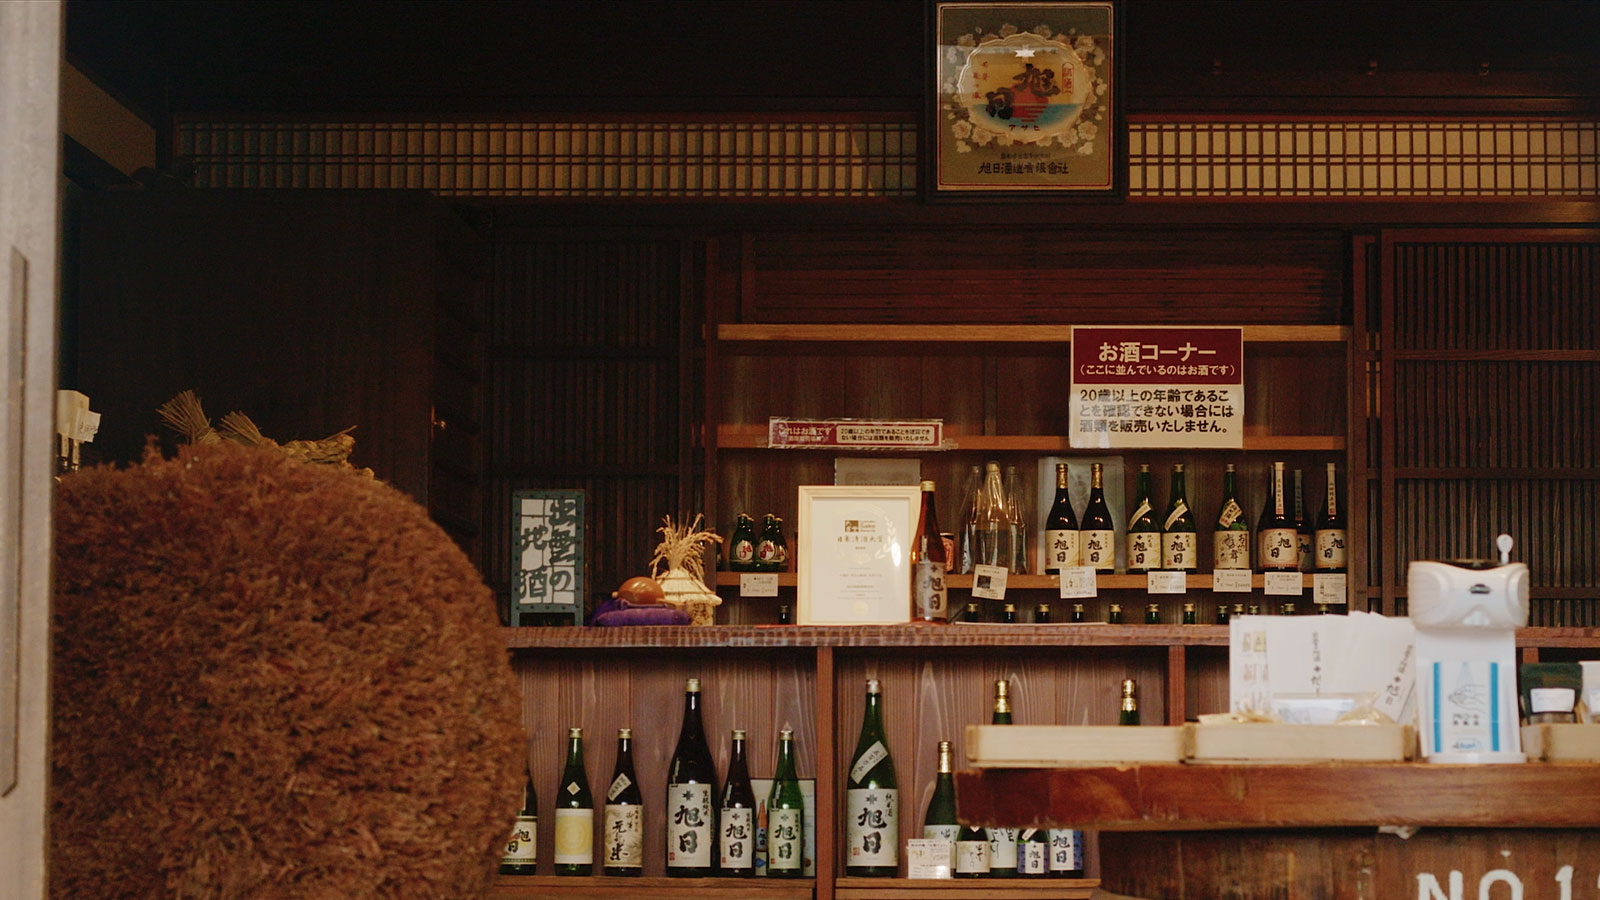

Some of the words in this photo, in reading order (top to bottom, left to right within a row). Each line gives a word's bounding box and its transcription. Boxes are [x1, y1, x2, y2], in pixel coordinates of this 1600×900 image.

[1098, 342, 1217, 363] お酒コーナー
[1080, 364, 1235, 377] （ここに並んでいるのはお酒です）
[1080, 389, 1230, 402] 20歳以上の年齢であるこ
[1080, 404, 1234, 417] とを確認できない場合には
[1080, 419, 1228, 433] 酒類を販売いたしません。
[1055, 539, 1069, 563] 旭日
[1088, 539, 1102, 563] 旭日
[1133, 541, 1148, 564] 旭日
[1170, 541, 1185, 564] 旭日
[1270, 537, 1292, 558] 旭日
[1324, 537, 1345, 558] 旭日
[520, 524, 548, 599] 地酒
[674, 805, 705, 854] 旭日
[725, 823, 748, 858] 旭日
[858, 807, 887, 855] 旭日
[774, 824, 796, 859] 旭日
[1053, 834, 1070, 863] 旭日
[1029, 850, 1041, 869] 旭日
